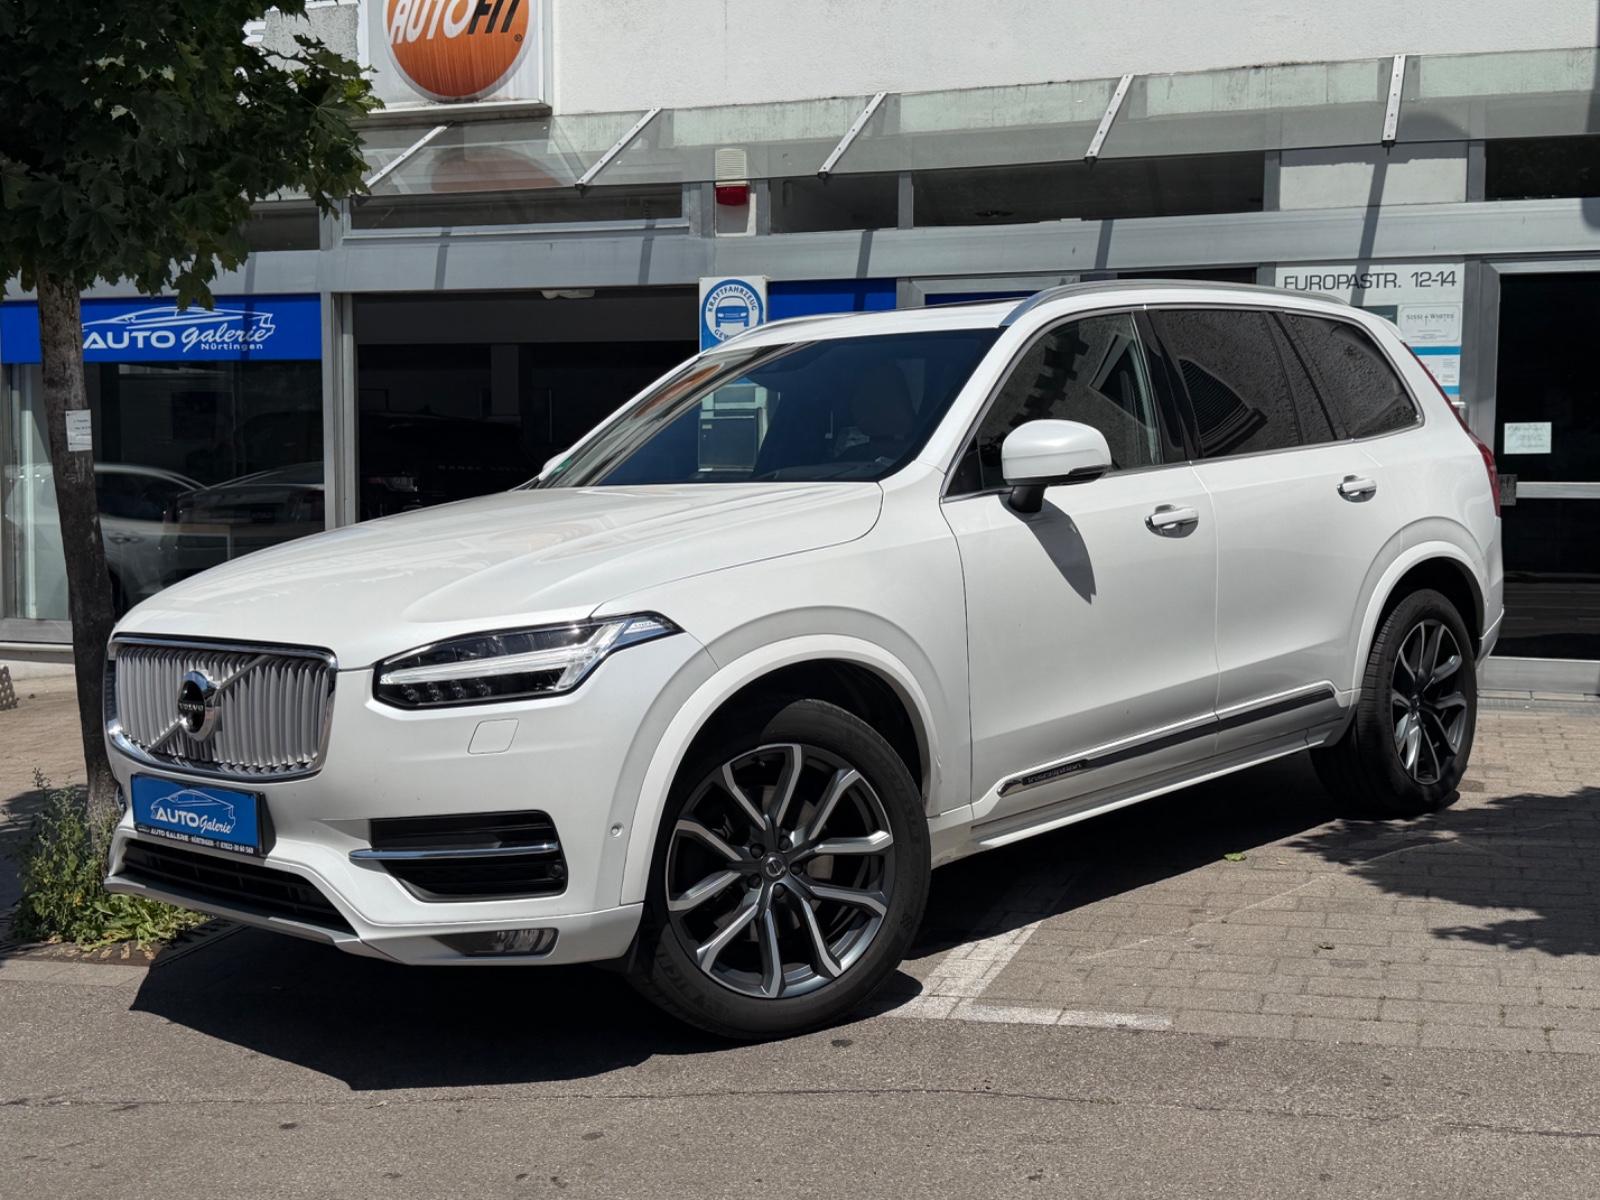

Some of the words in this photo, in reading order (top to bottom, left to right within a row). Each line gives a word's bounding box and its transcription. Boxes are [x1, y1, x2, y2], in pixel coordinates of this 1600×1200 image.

[1410, 270, 1457, 288] 12-14
[707, 286, 758, 312] KRAFTFAHRZEUG
[83, 331, 176, 349] AUTO
[180, 323, 270, 352] galerie
[200, 343, 263, 351] Nürtingen
[155, 807, 199, 828] AUTO
